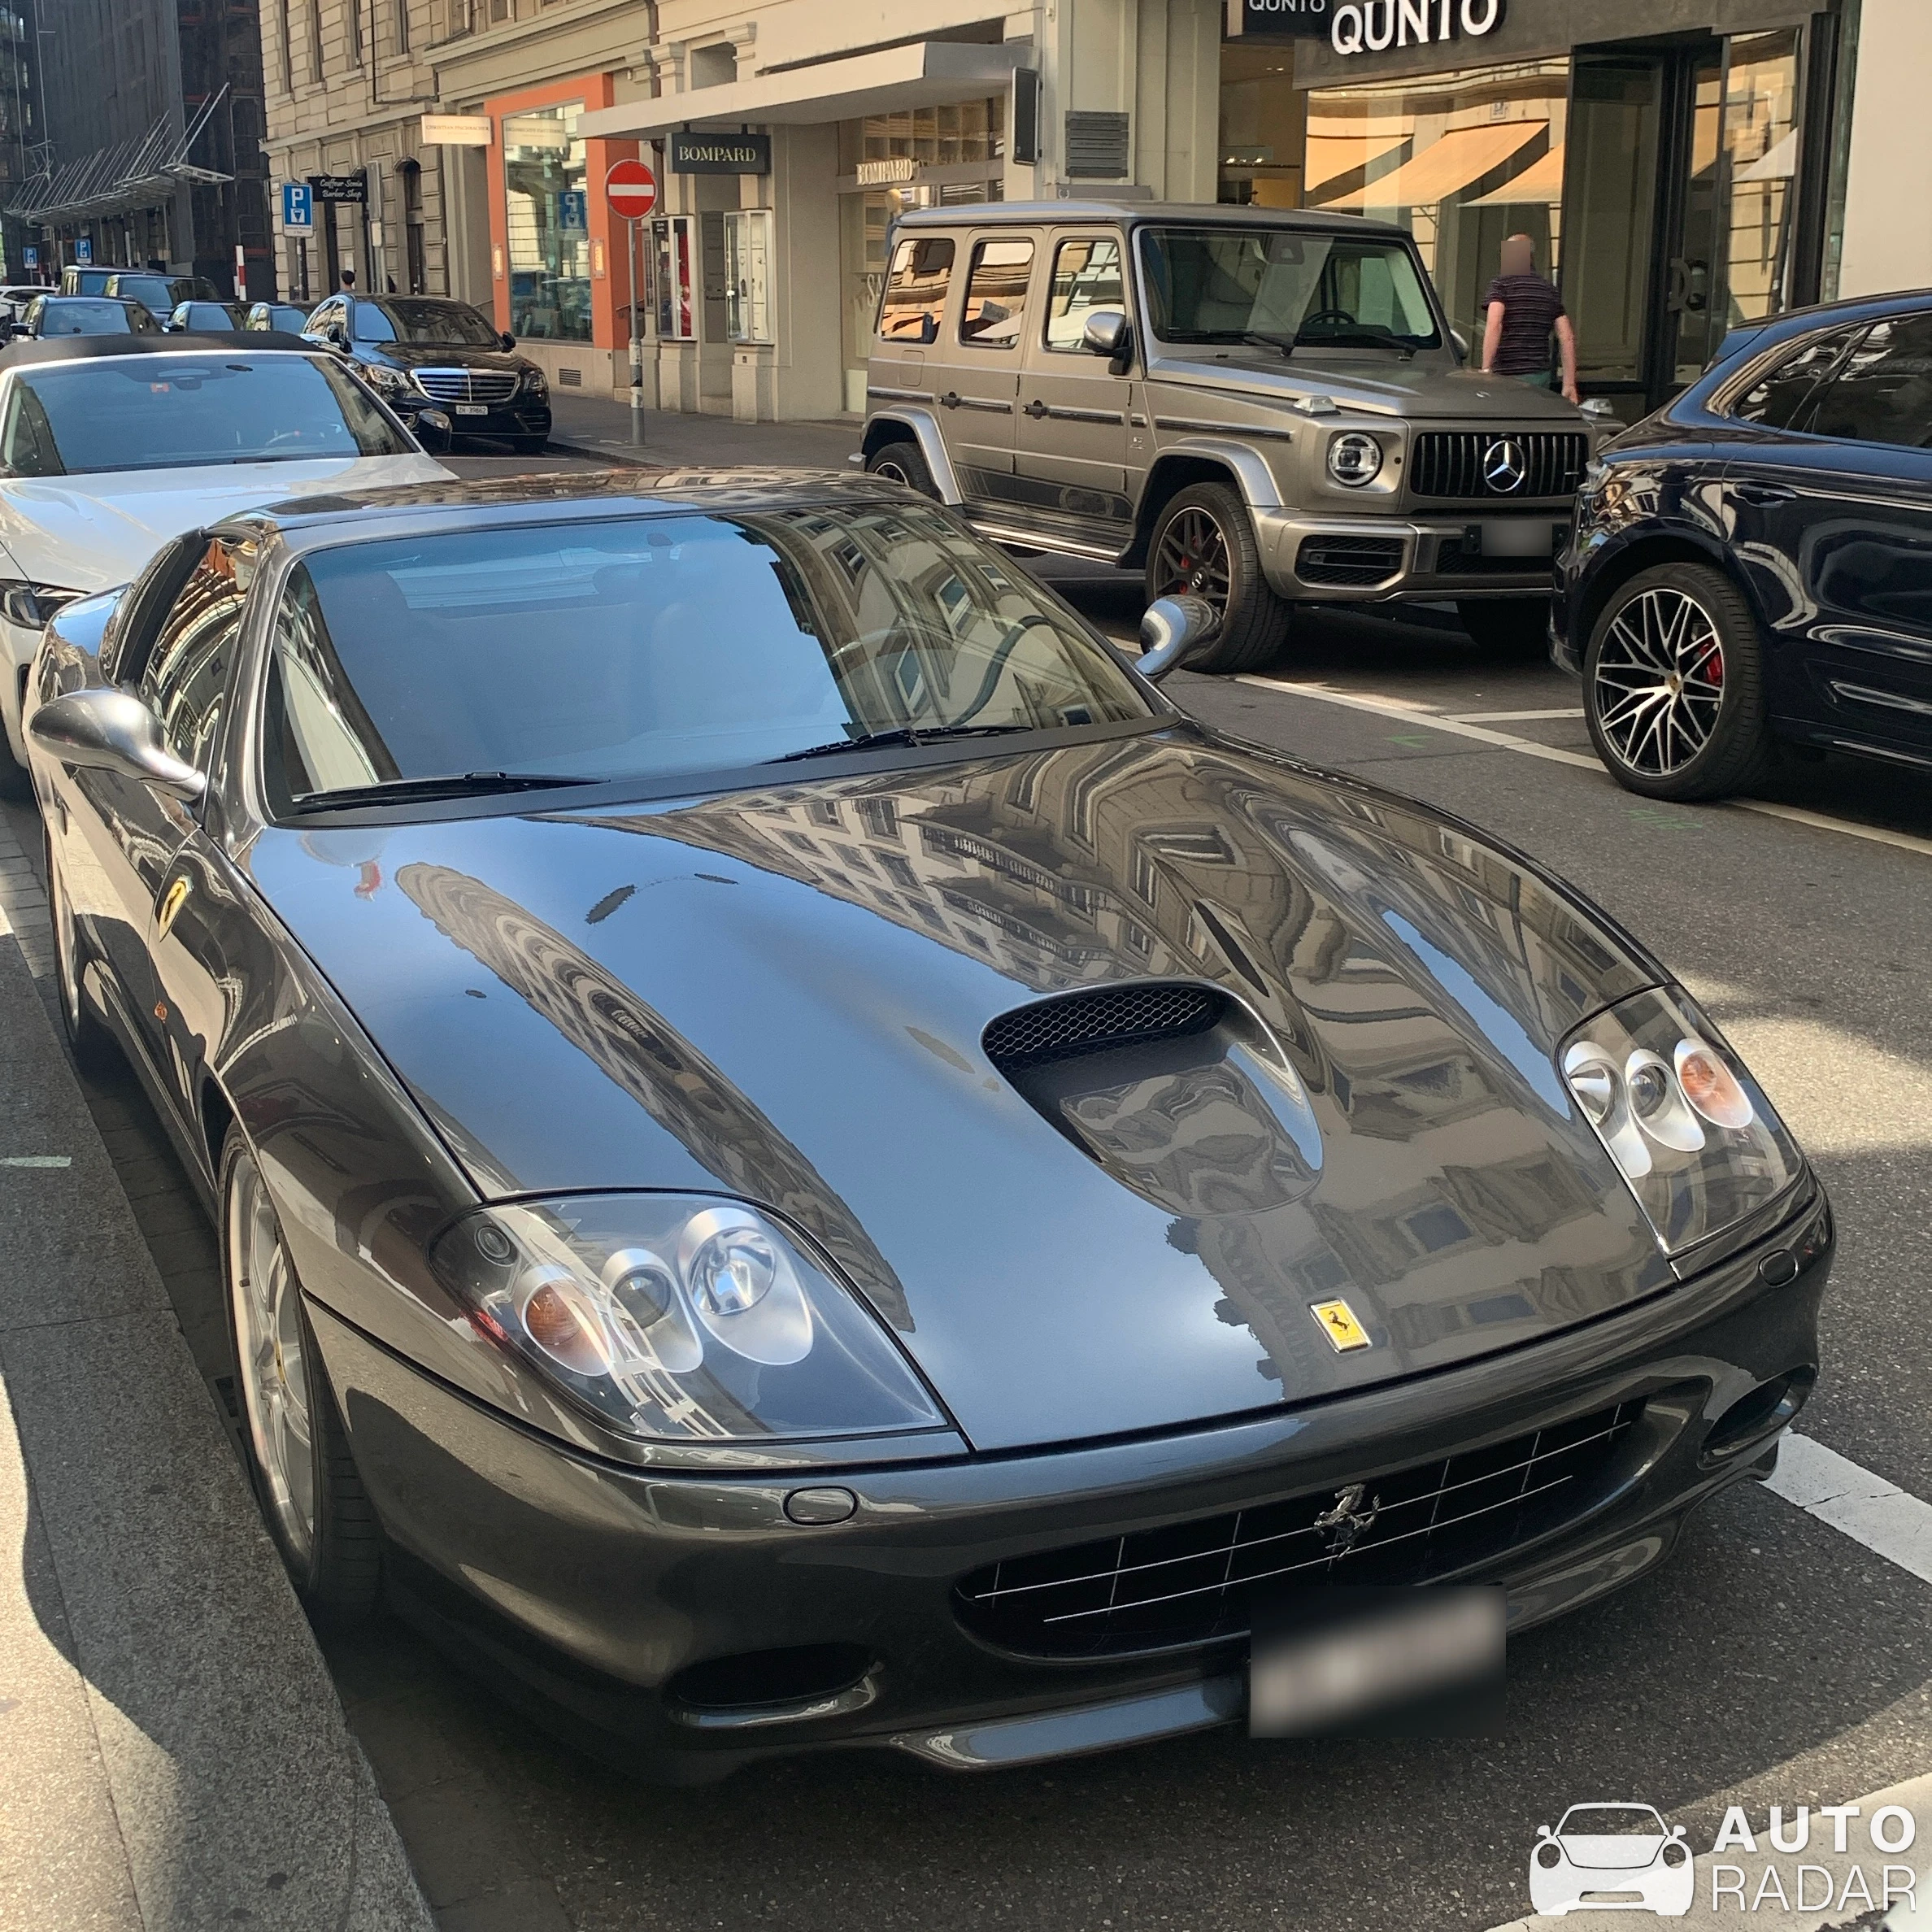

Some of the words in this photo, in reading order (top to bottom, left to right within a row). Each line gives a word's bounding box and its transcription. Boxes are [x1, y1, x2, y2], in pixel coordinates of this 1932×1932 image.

[1331, 0, 1498, 54] QUNTO
[679, 146, 756, 162] BOMPARD
[856, 159, 913, 185] BOMPARD
[291, 188, 304, 207] P
[322, 188, 345, 198] Barber
[346, 189, 363, 202] Shop
[80, 242, 87, 252] P
